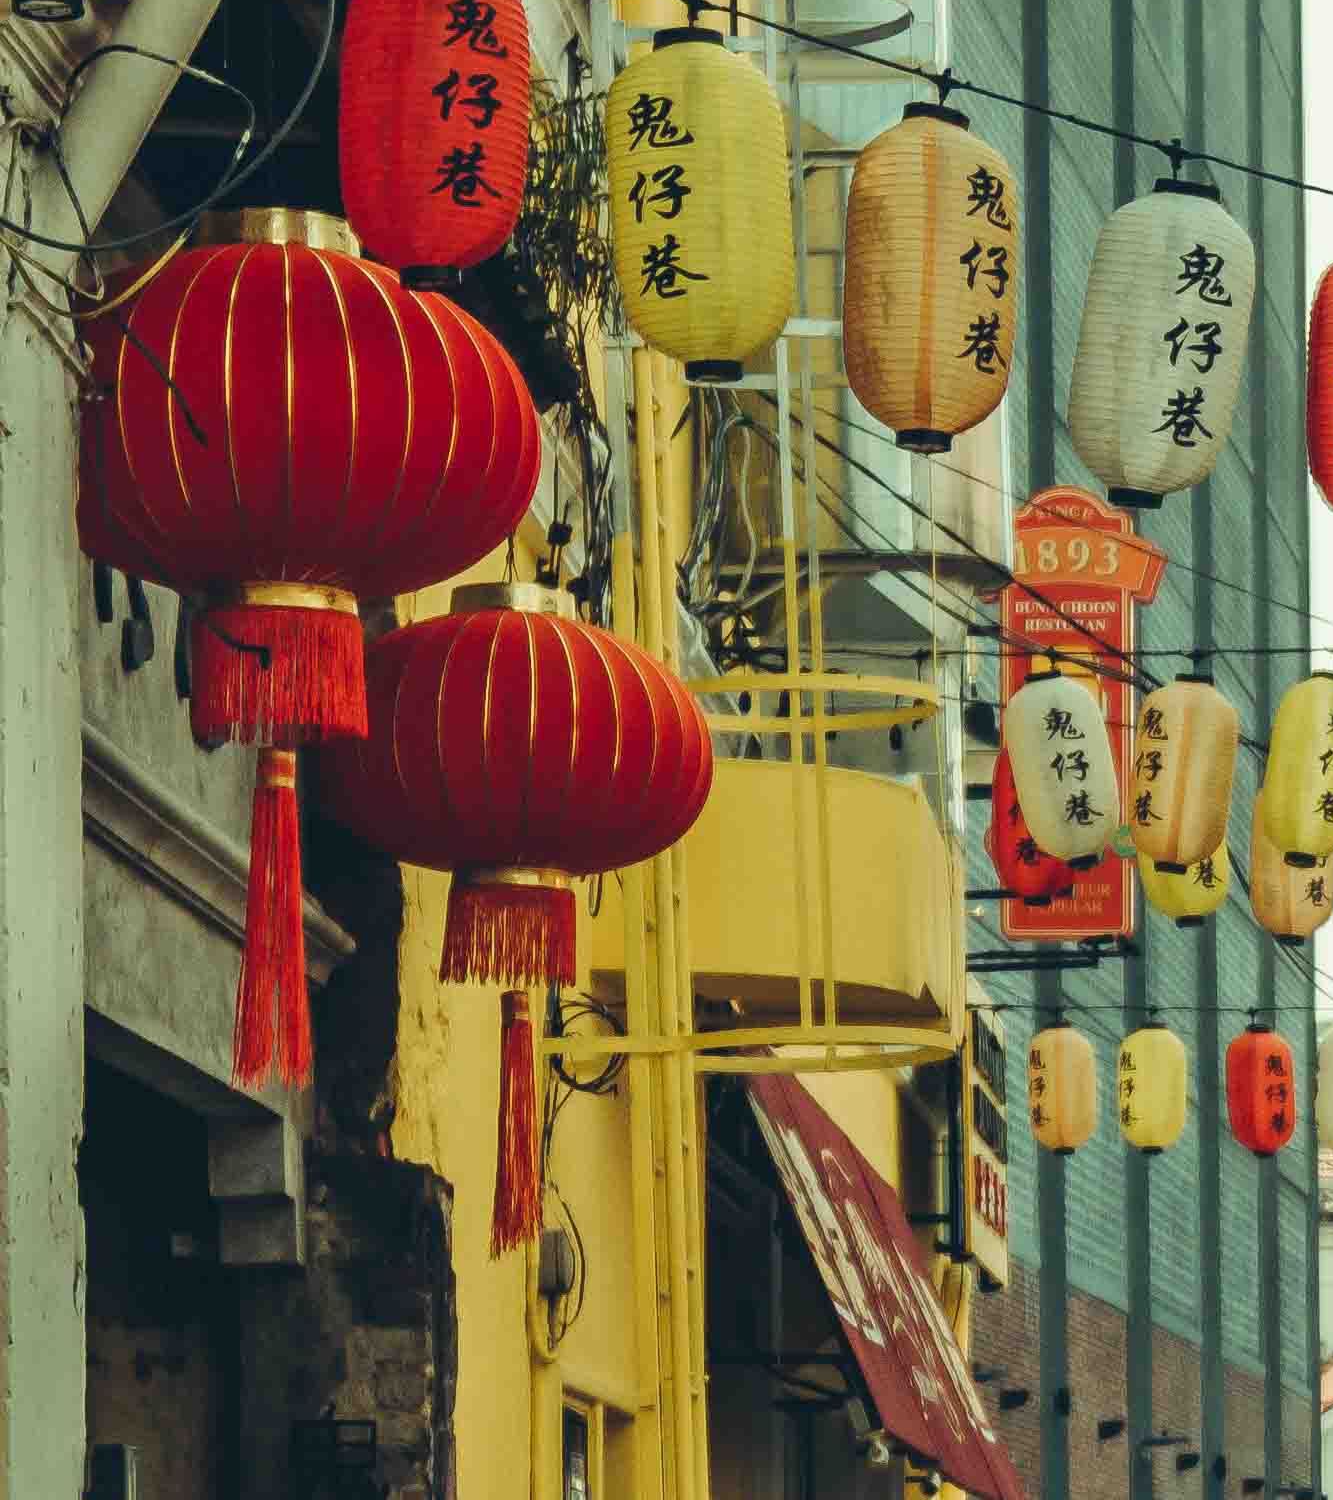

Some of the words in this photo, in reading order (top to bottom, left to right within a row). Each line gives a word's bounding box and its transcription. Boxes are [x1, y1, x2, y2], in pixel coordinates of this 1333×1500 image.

[626, 93, 708, 299] 鬼仔巷
[955, 164, 1012, 375] 鬼仔巷
[1151, 243, 1232, 449] 鬼仔巷
[1015, 536, 1120, 576] 1893
[1040, 706, 1104, 826] 鬼仔巷
[1131, 706, 1169, 828] 鬼仔巷
